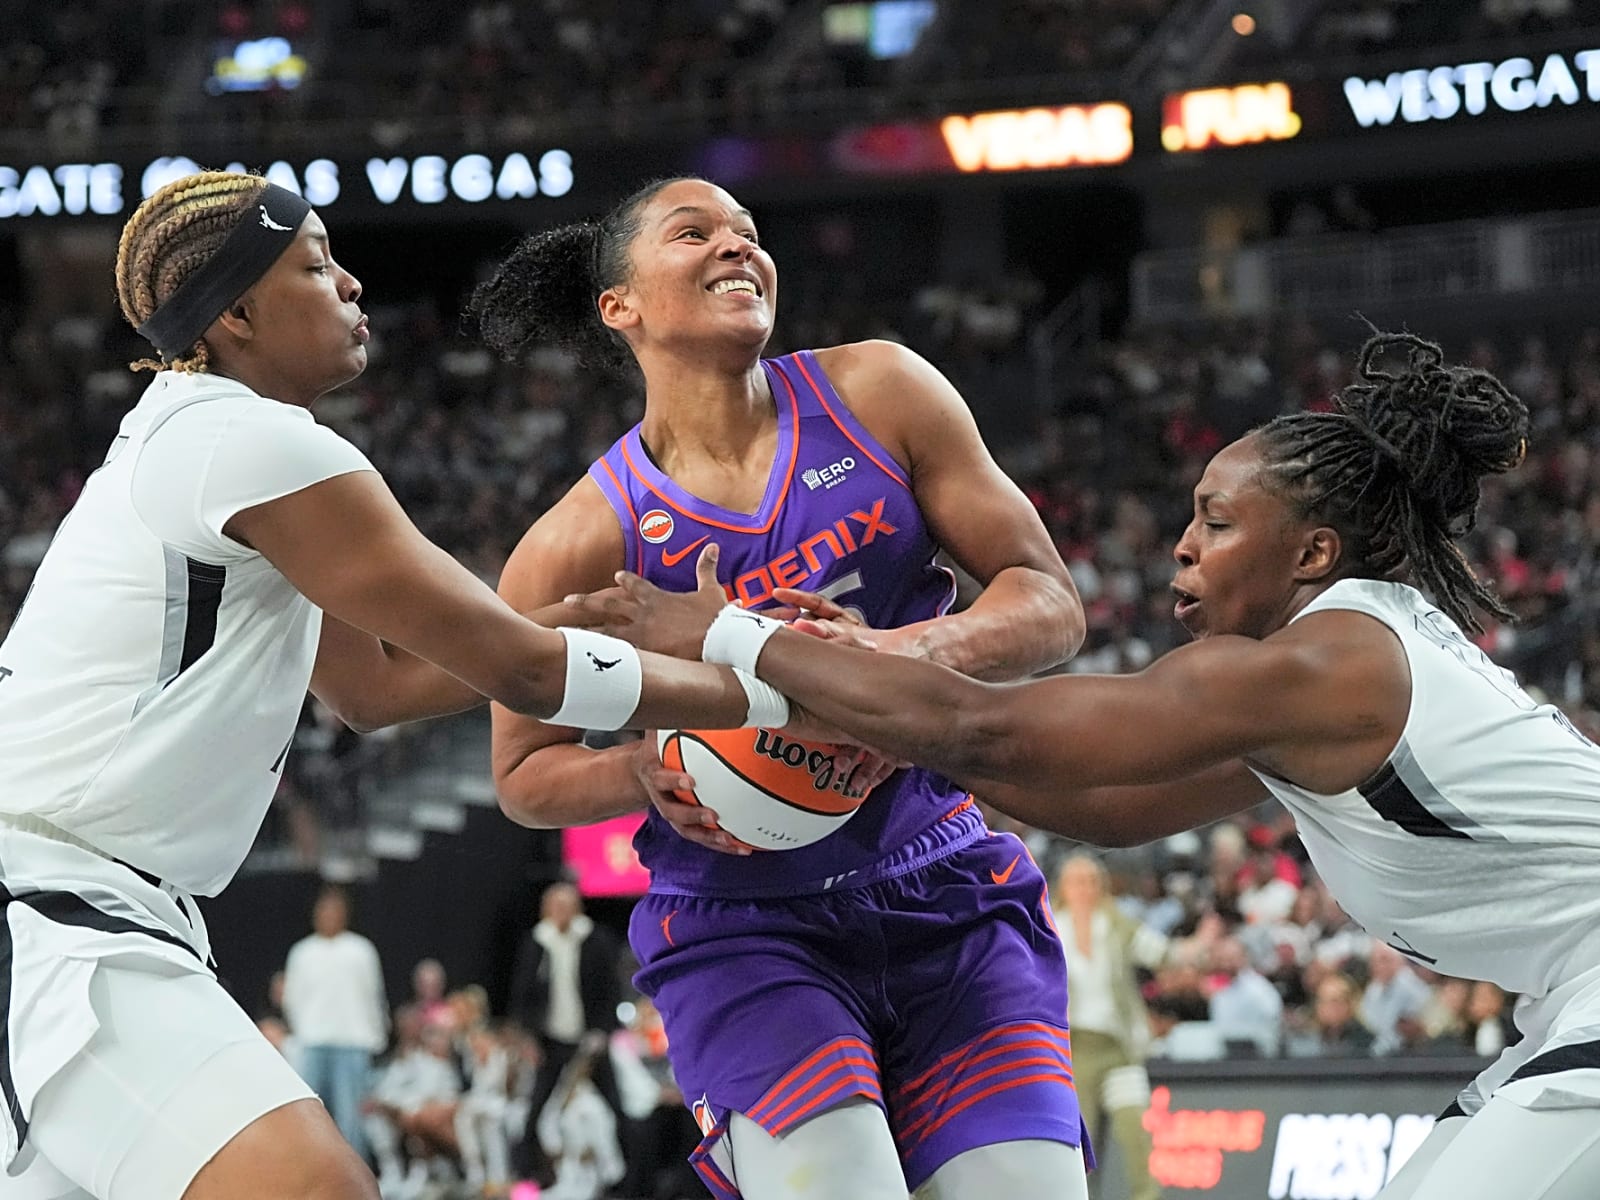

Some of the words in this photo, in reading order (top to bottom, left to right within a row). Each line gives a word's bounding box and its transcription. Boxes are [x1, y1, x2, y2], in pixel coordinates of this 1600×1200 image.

[1343, 49, 1600, 128] WESTGAT
[942, 103, 1133, 172] VEGAS
[366, 149, 573, 204] VEGAS
[723, 497, 898, 609] OENIX
